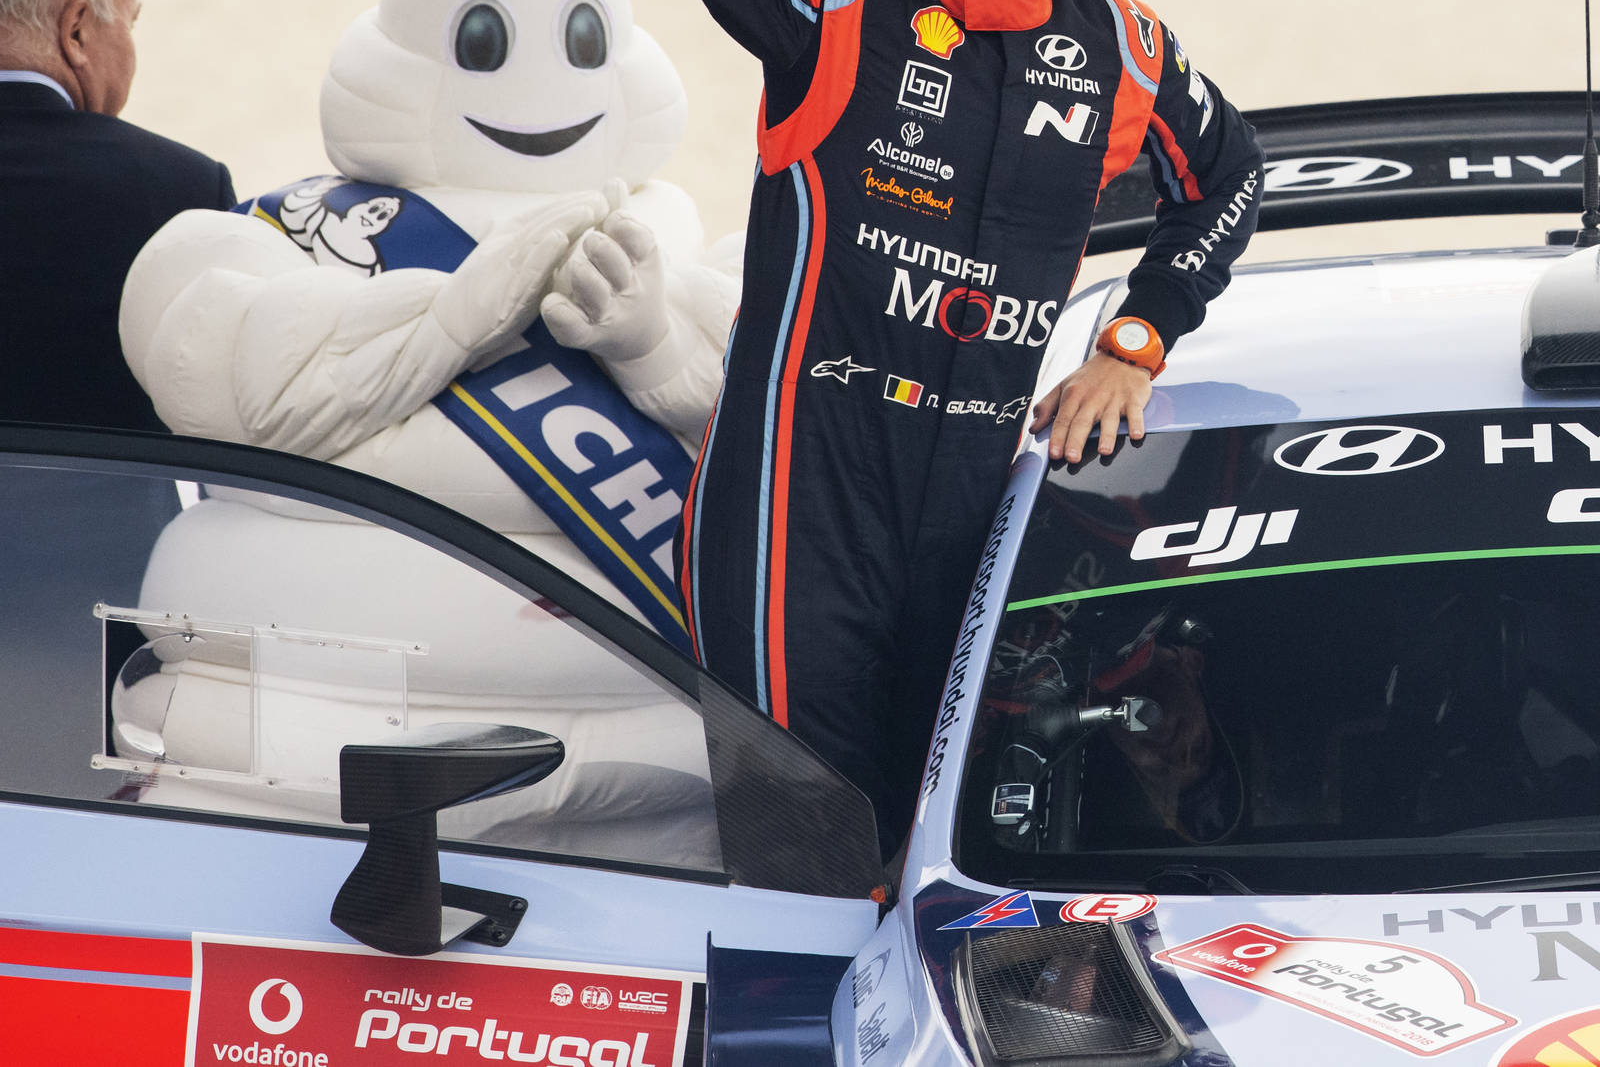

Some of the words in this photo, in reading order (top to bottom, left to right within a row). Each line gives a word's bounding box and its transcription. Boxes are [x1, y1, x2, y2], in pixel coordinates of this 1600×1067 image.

[1025, 67, 1101, 95] HYUNDAI
[866, 138, 942, 174] Alcomel
[911, 187, 954, 215] Gilsoul
[857, 222, 998, 287] HYUNDAI
[884, 266, 1057, 348] MOBIS
[946, 400, 997, 416] GILSOUL
[923, 493, 1017, 798] motorsport.hyundai.com
[1084, 897, 1134, 917] E
[1192, 950, 1257, 974] vodafone
[1306, 958, 1347, 976] rally
[1348, 970, 1375, 983] de
[1365, 955, 1422, 974] 5
[364, 987, 433, 1012] rally
[436, 990, 474, 1011] de
[619, 989, 669, 1005] WRC
[1272, 964, 1465, 1038] Portugal
[354, 1009, 650, 1067] Portugal
[213, 1041, 329, 1067] vodafone
